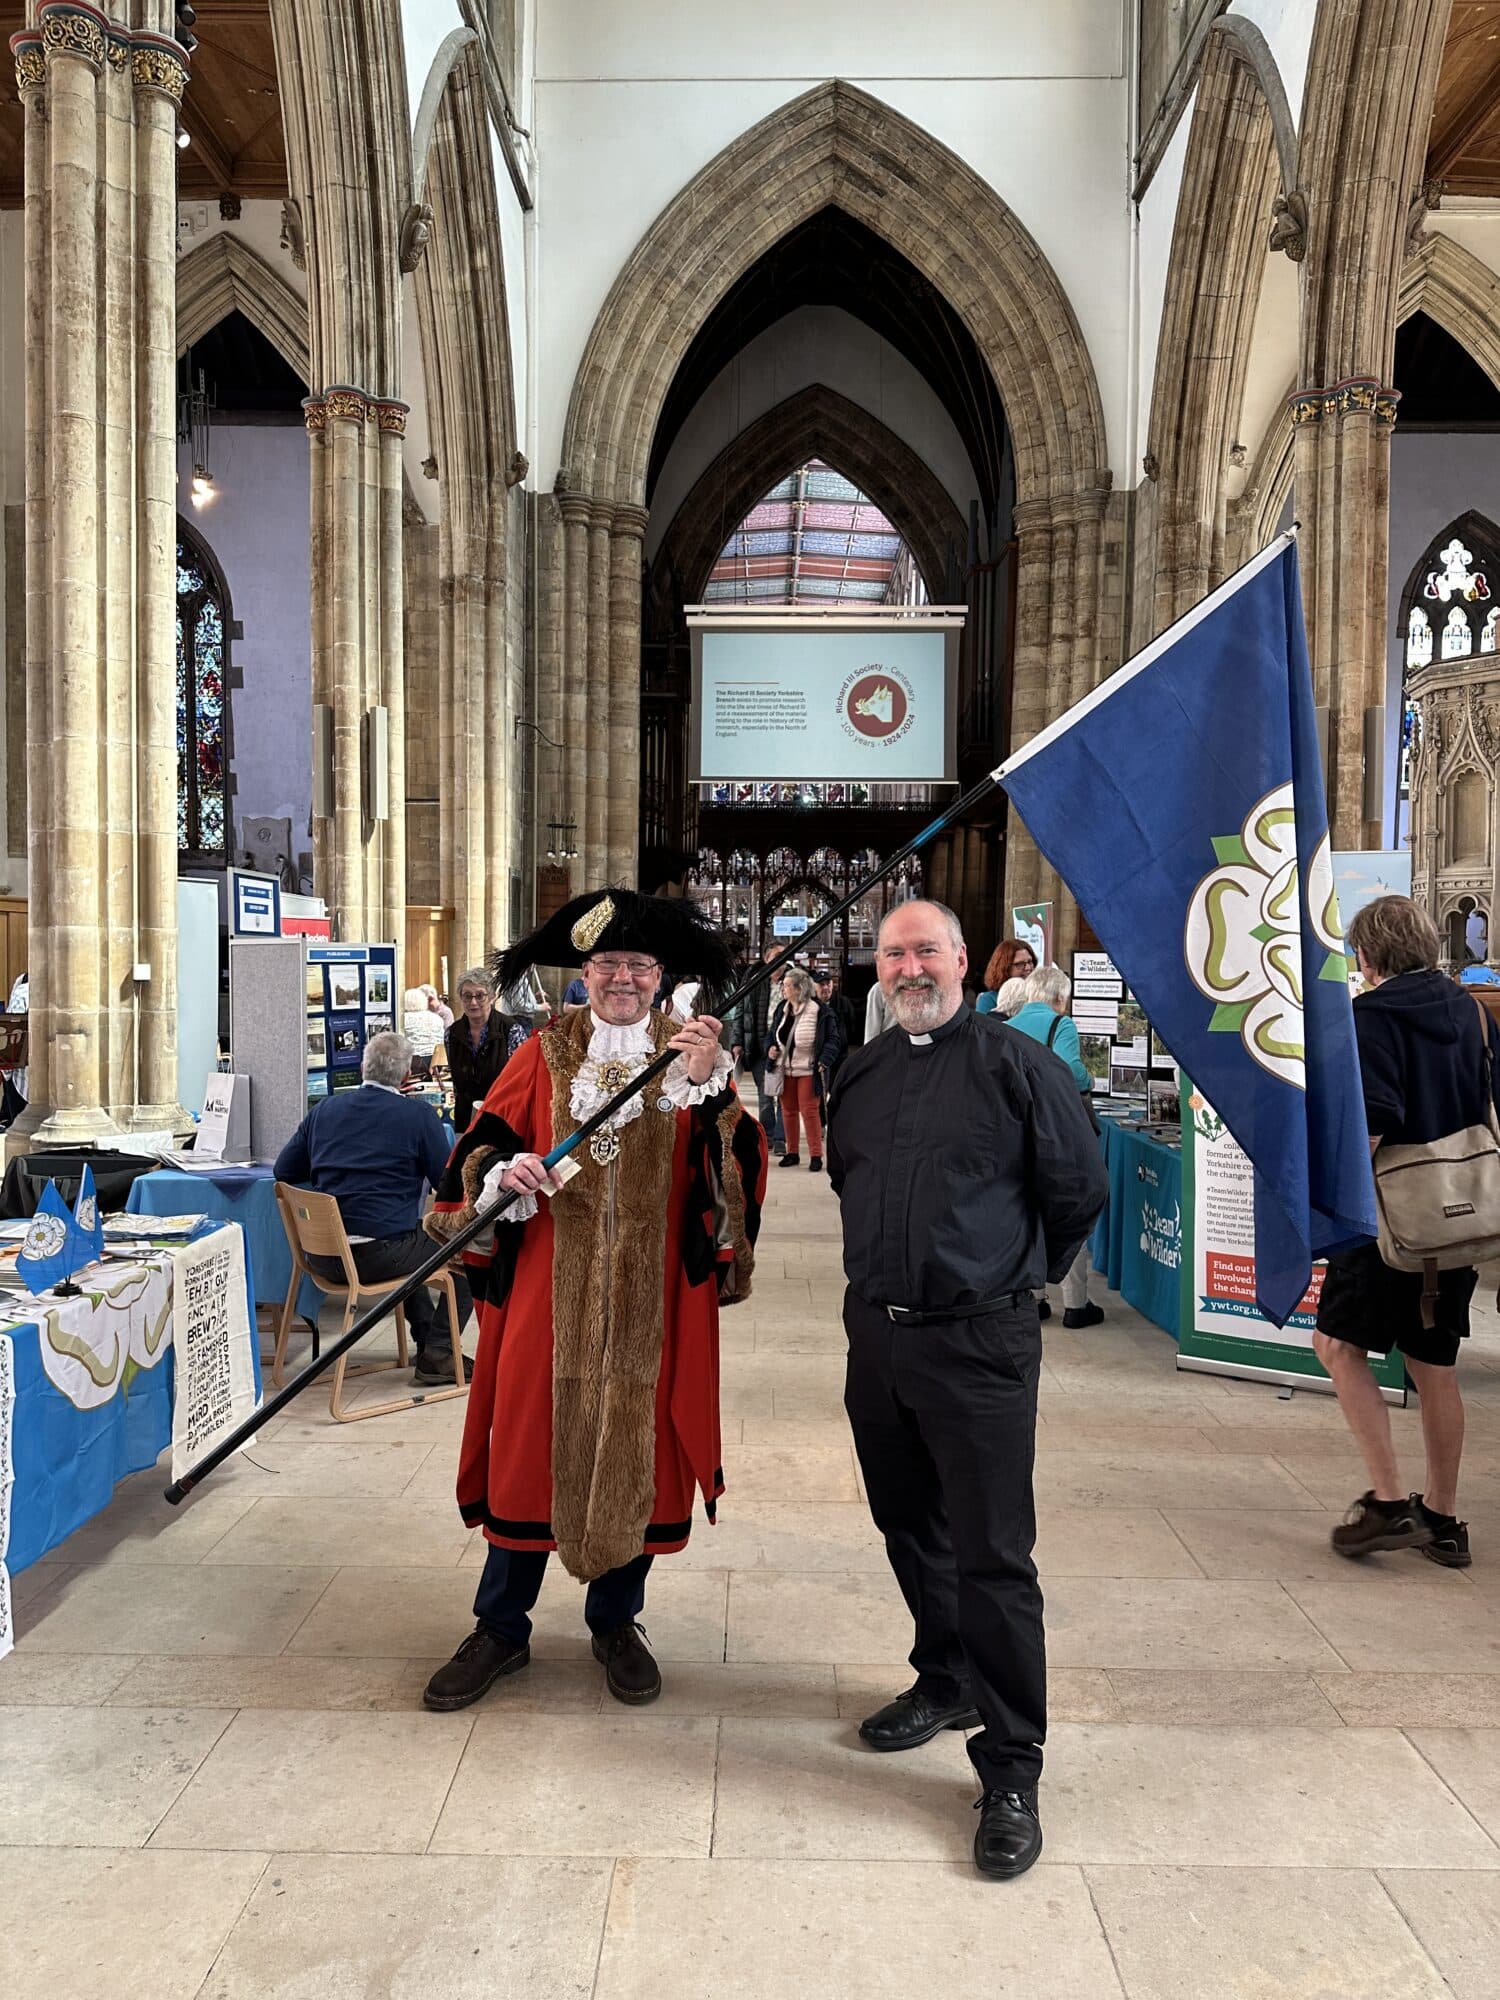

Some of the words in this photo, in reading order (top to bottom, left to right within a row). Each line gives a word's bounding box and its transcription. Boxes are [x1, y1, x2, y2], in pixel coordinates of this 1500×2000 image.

[836, 682, 849, 714] Richard
[854, 664, 883, 676] Society
[891, 666, 916, 702] Centenary
[841, 722, 855, 737] 100
[854, 736, 875, 748] years
[883, 714, 915, 746] 1924-2024
[1206, 1150, 1232, 1159] formed
[1207, 1160, 1241, 1170] Yorkshire
[1220, 1172, 1247, 1181] change
[1207, 1187, 1248, 1196] #TeamWilder
[1153, 1208, 1174, 1238] Team
[1207, 1226, 1225, 1234] urban
[1150, 1234, 1178, 1268] Wilder
[186, 1257, 214, 1277] YORKSHIRE
[1213, 1261, 1233, 1271] Find
[1213, 1271, 1248, 1284] involved
[1213, 1283, 1229, 1292] the
[1211, 1301, 1261, 1316] ywt.org.u
[187, 1315, 217, 1345] BREW?
